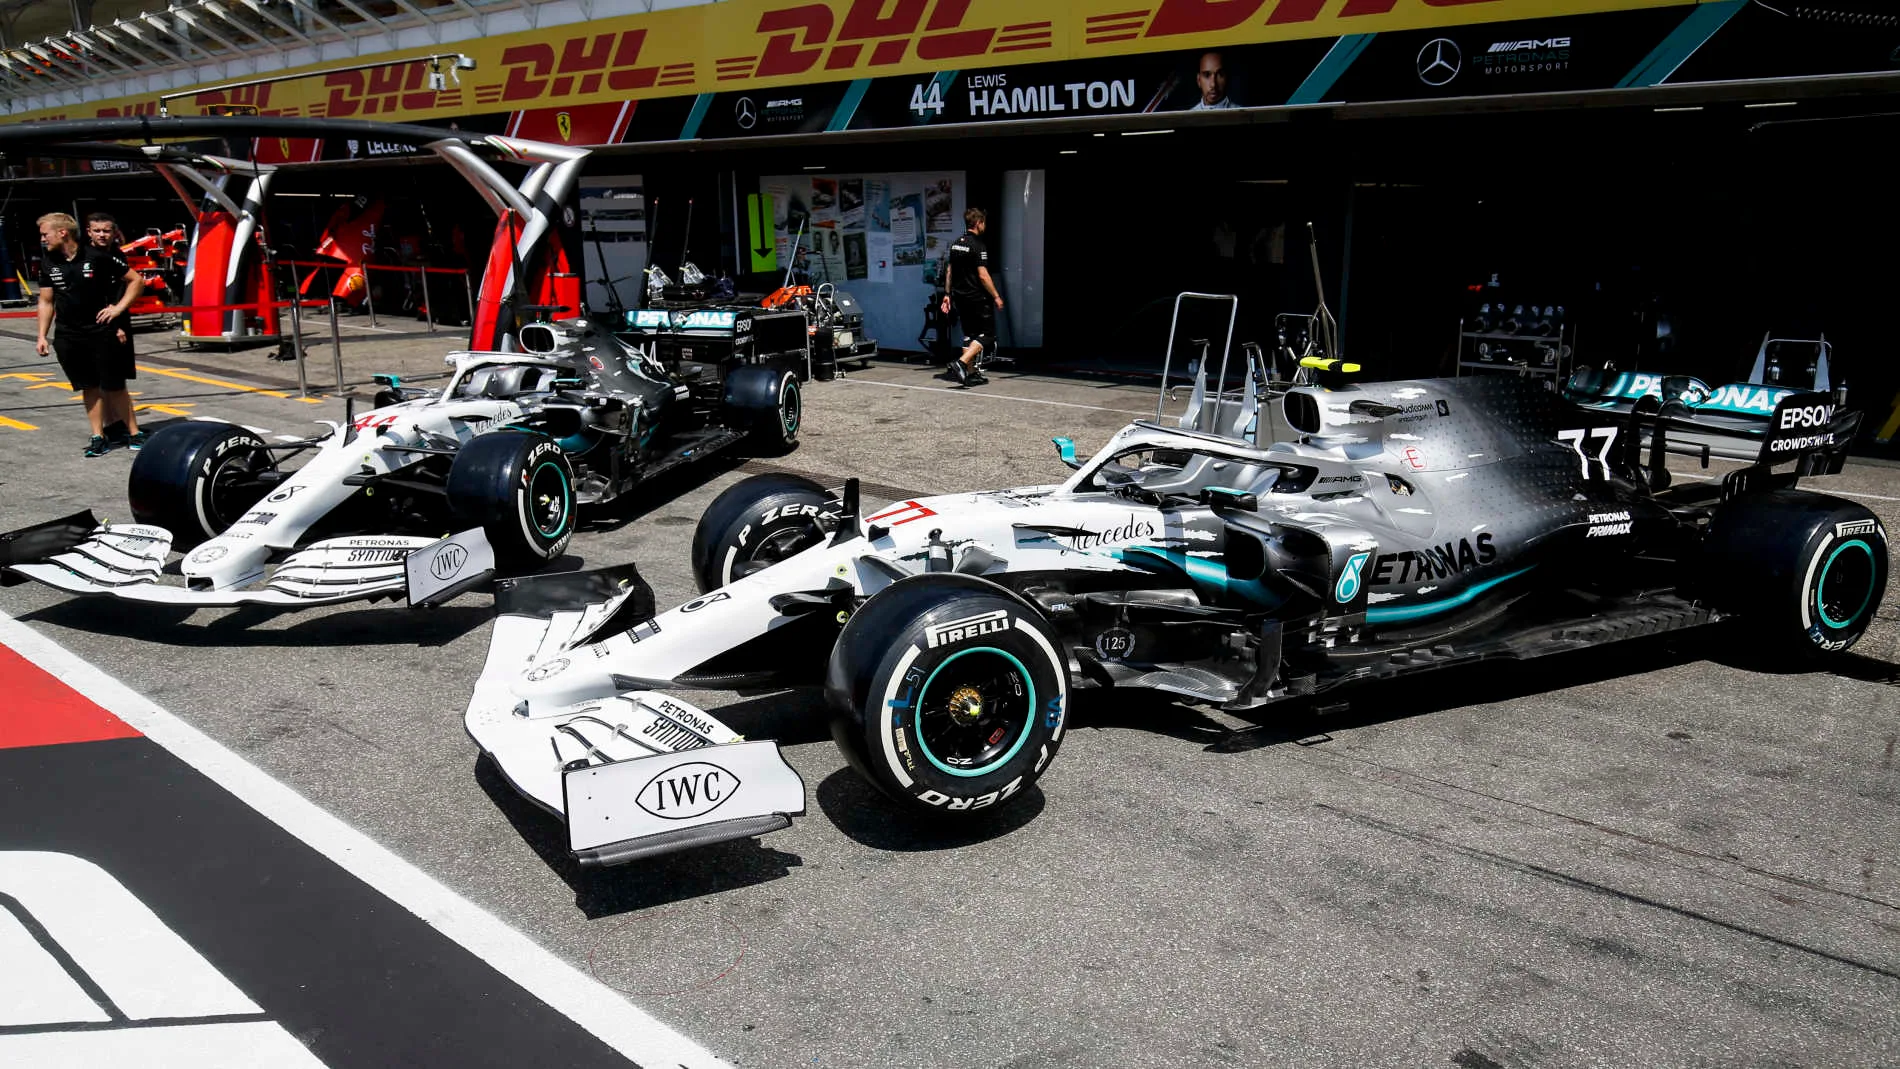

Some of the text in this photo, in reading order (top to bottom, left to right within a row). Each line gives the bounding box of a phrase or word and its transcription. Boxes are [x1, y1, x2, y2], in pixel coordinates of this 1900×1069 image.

[754, 0, 997, 78] DHL
[500, 28, 660, 102] DHL
[1472, 49, 1570, 66] PETRONAS
[1484, 62, 1569, 75] MOTORSPORT
[325, 61, 438, 117] DHL
[968, 74, 1006, 88] LEWIS
[969, 79, 1136, 116] HAMILTON
[909, 83, 945, 116] 44
[1780, 404, 1835, 429] EPSON
[528, 442, 560, 467] ZERO
[1558, 427, 1618, 481] 77
[865, 501, 938, 526] 77
[1586, 521, 1633, 537] PRIMAX
[1589, 511, 1631, 524] PETRONAS
[1835, 518, 1875, 538] PIRELLI
[1061, 513, 1154, 556] Mercedes
[436, 548, 460, 575] IWC
[1368, 532, 1497, 585] ETRONAS
[925, 609, 1009, 649] PIRELLI
[1105, 636, 1126, 650] 125
[658, 700, 714, 734] PETRONAS
[656, 771, 721, 811] IWC
[917, 775, 1022, 810] ZERO
